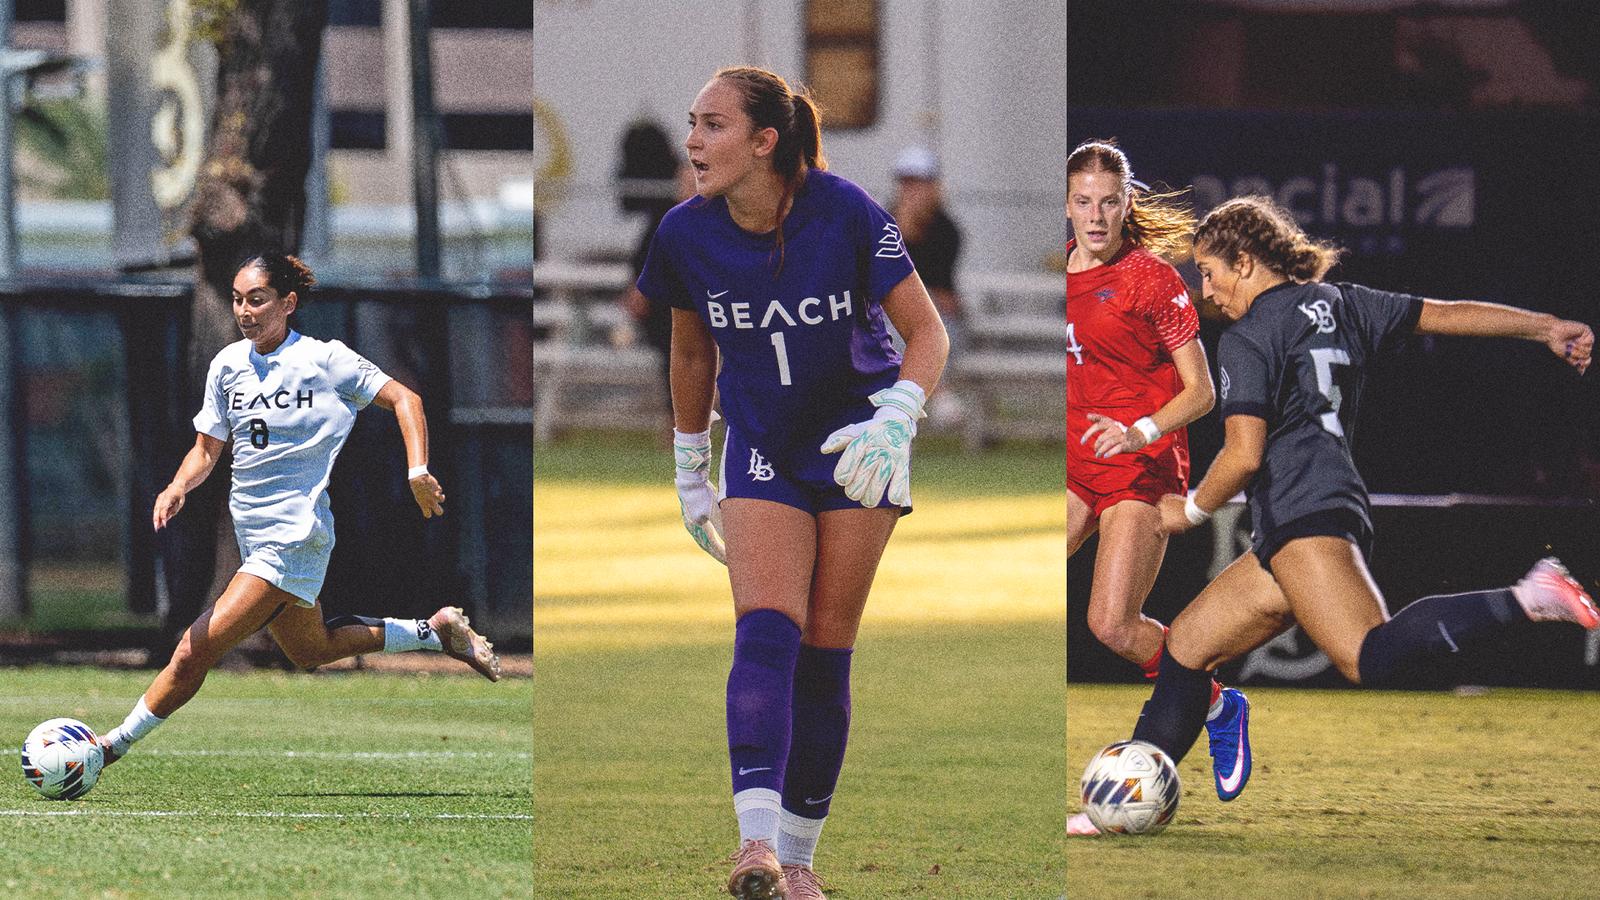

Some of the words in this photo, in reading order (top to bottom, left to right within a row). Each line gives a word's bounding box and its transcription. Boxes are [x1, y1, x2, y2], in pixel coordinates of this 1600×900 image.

[707, 290, 853, 329] BEACH
[770, 331, 792, 386] 1
[225, 389, 313, 410] EACH
[1309, 347, 1351, 438] 5
[250, 418, 269, 450] 8
